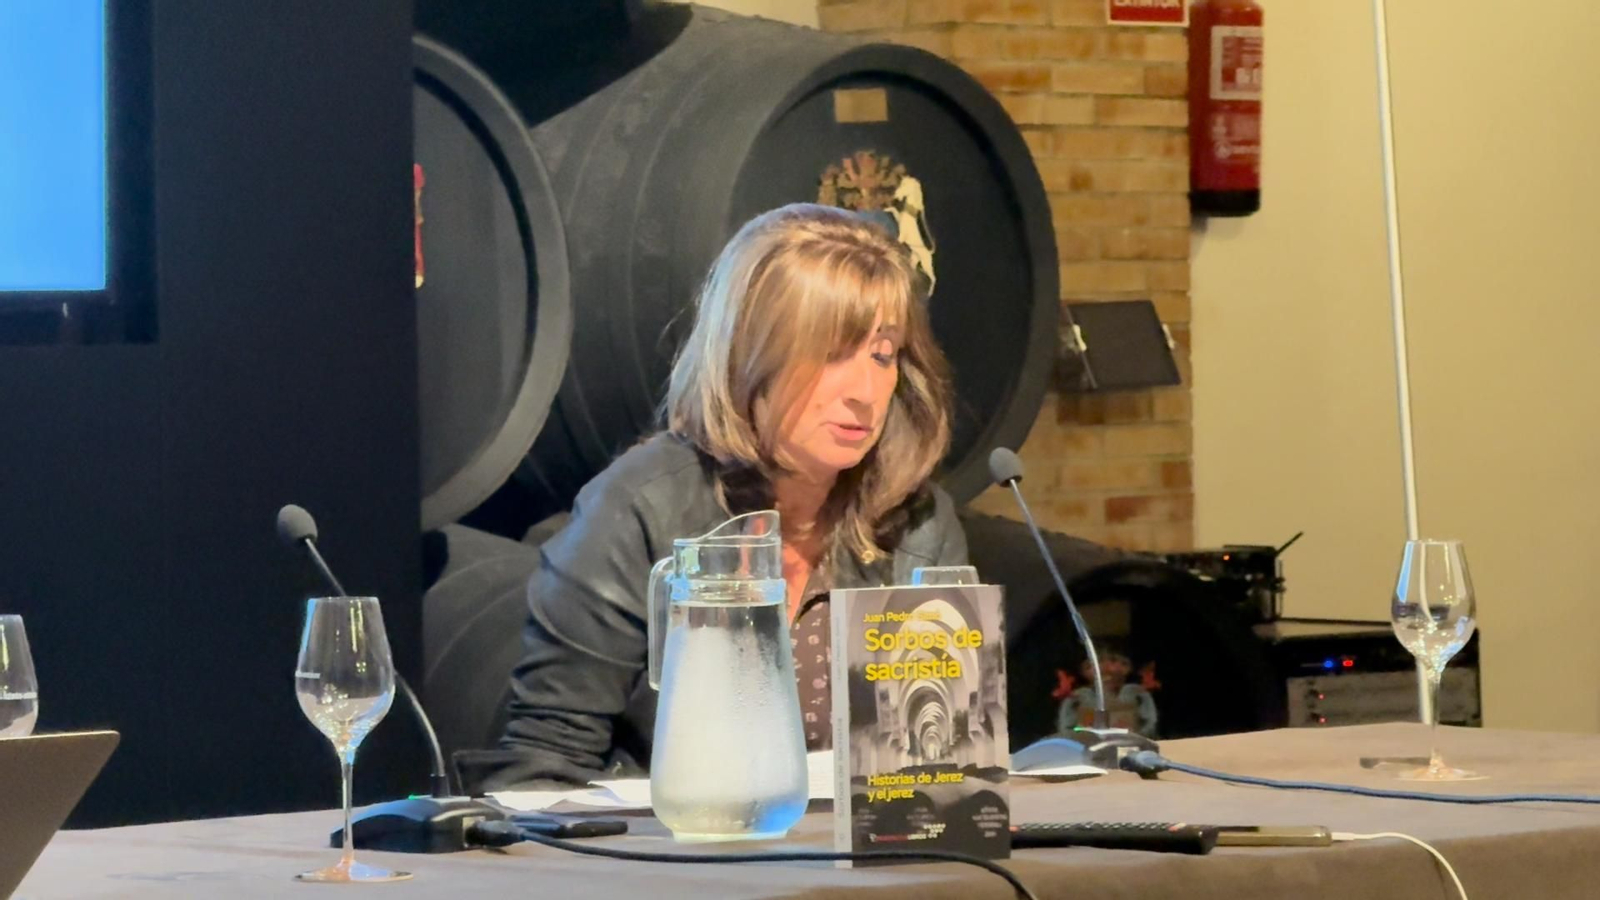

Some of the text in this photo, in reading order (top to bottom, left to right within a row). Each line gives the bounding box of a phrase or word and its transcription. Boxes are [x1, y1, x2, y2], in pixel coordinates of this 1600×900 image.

[863, 612, 885, 622] Juan
[865, 626, 982, 652] Sorbos de
[865, 654, 961, 681] sacristía
[867, 771, 963, 786] Historias de Jerez
[867, 787, 915, 803] y el jerez
